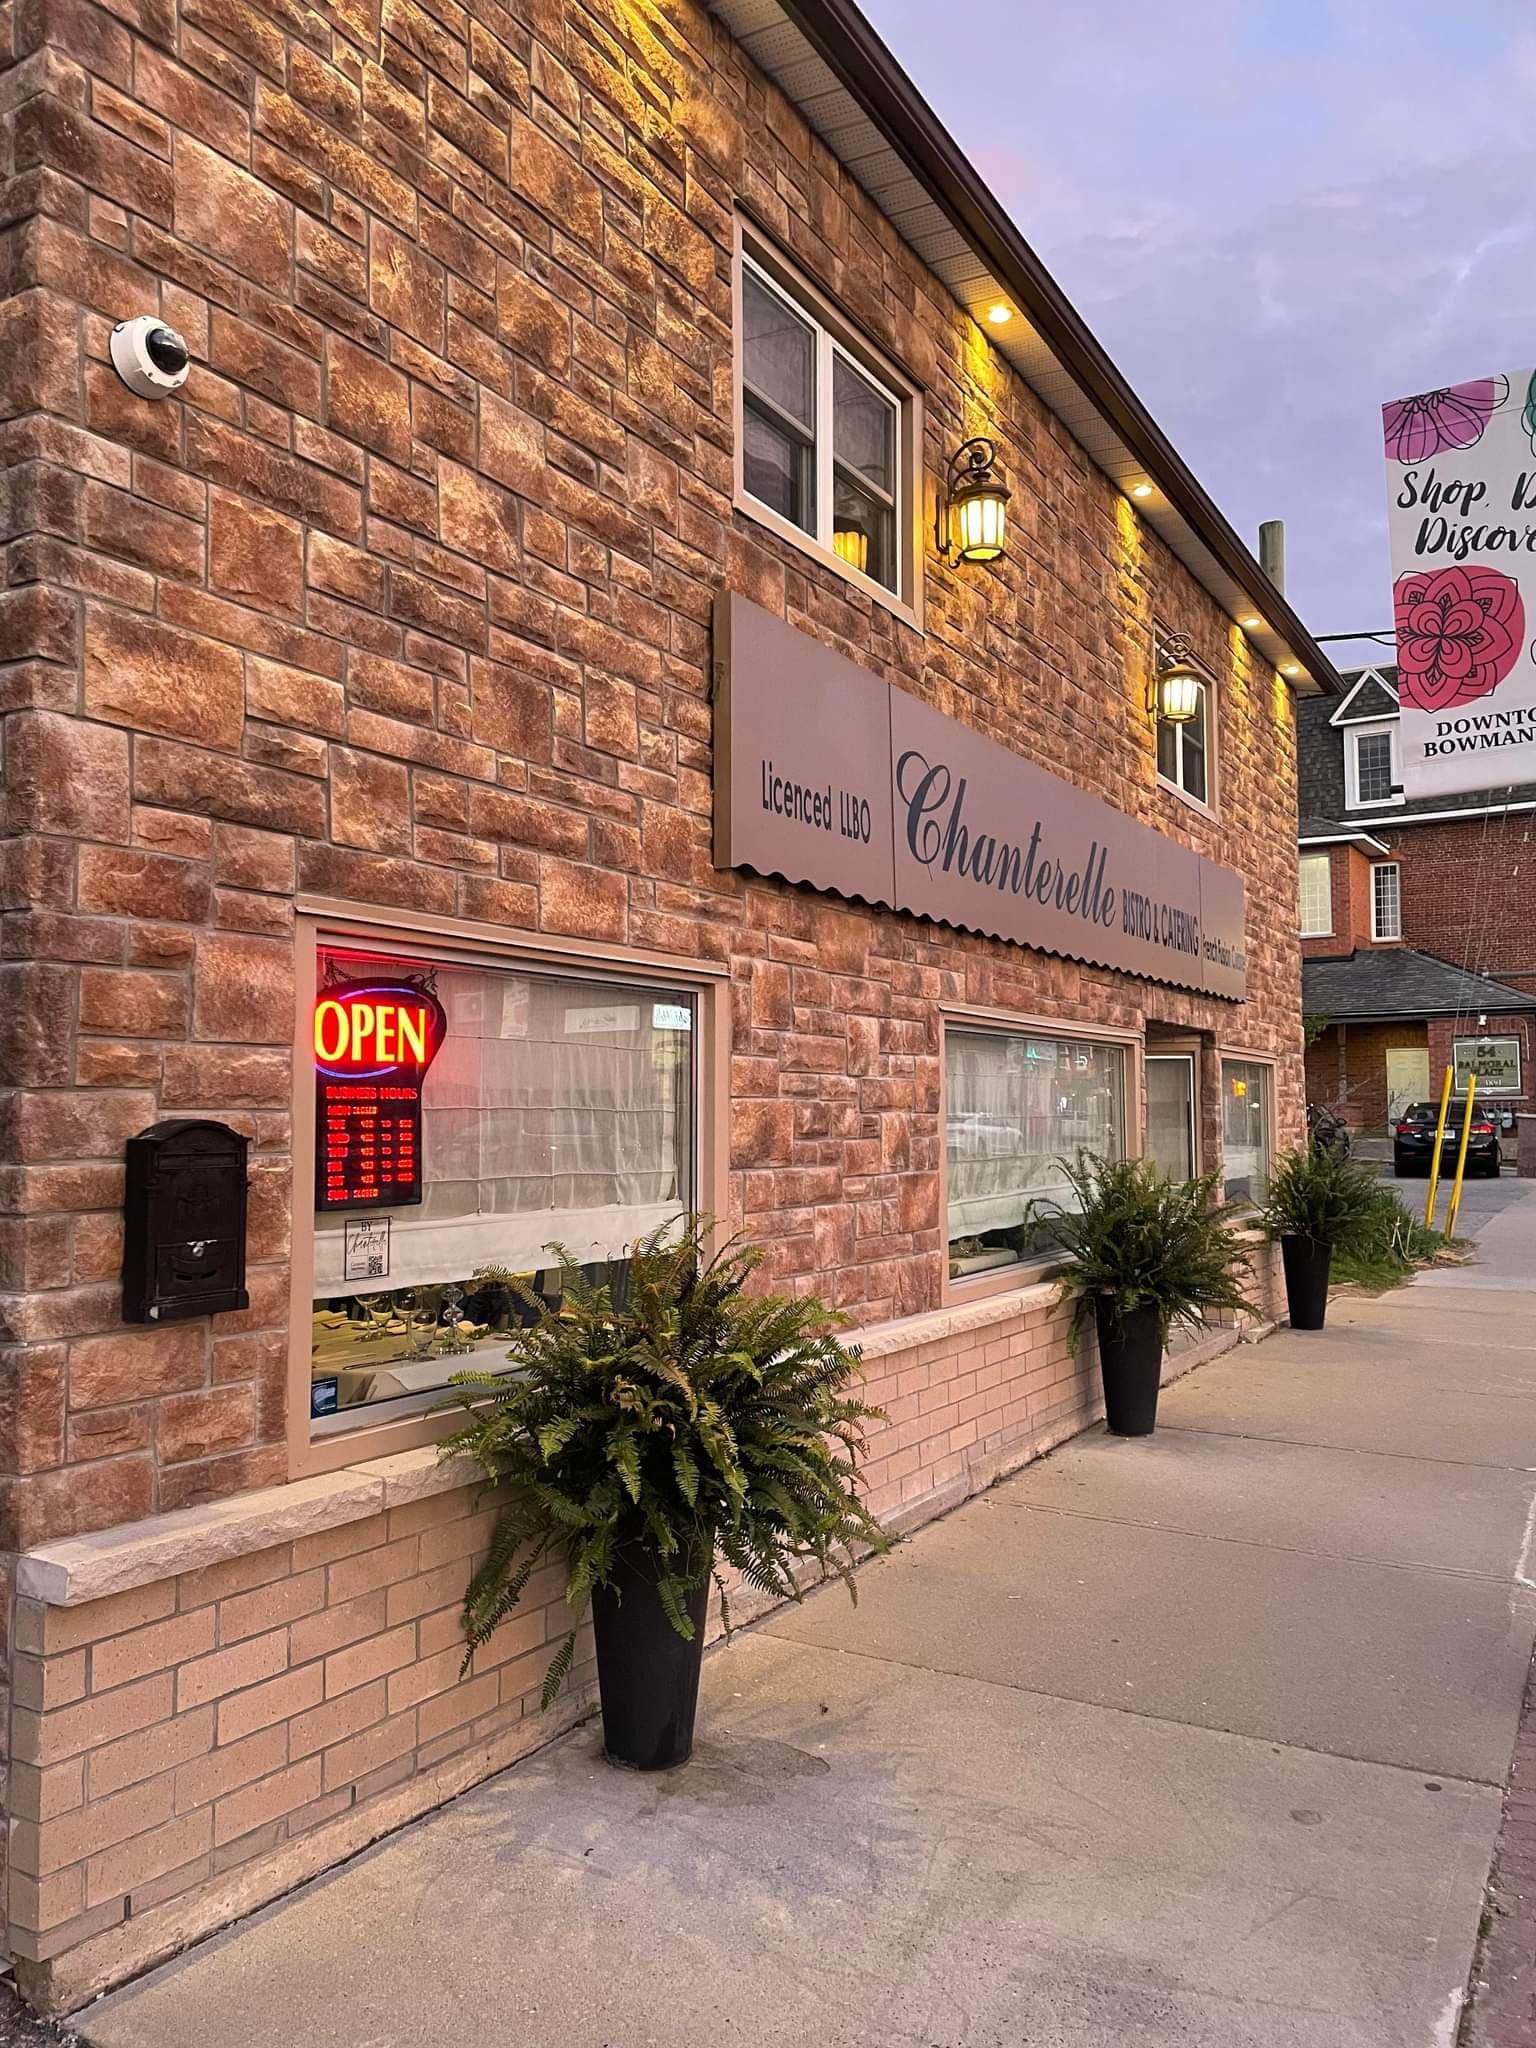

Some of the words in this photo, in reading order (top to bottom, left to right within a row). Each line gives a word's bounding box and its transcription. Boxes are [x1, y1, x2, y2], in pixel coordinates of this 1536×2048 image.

[761, 759, 832, 832] Licenced
[840, 790, 871, 844] LLBO
[896, 751, 1116, 928] Chanterelle
[1123, 889, 1152, 941] BISTRO
[1153, 903, 1160, 944] &
[1161, 904, 1199, 957] CATERING
[314, 1000, 426, 1064] OPEN
